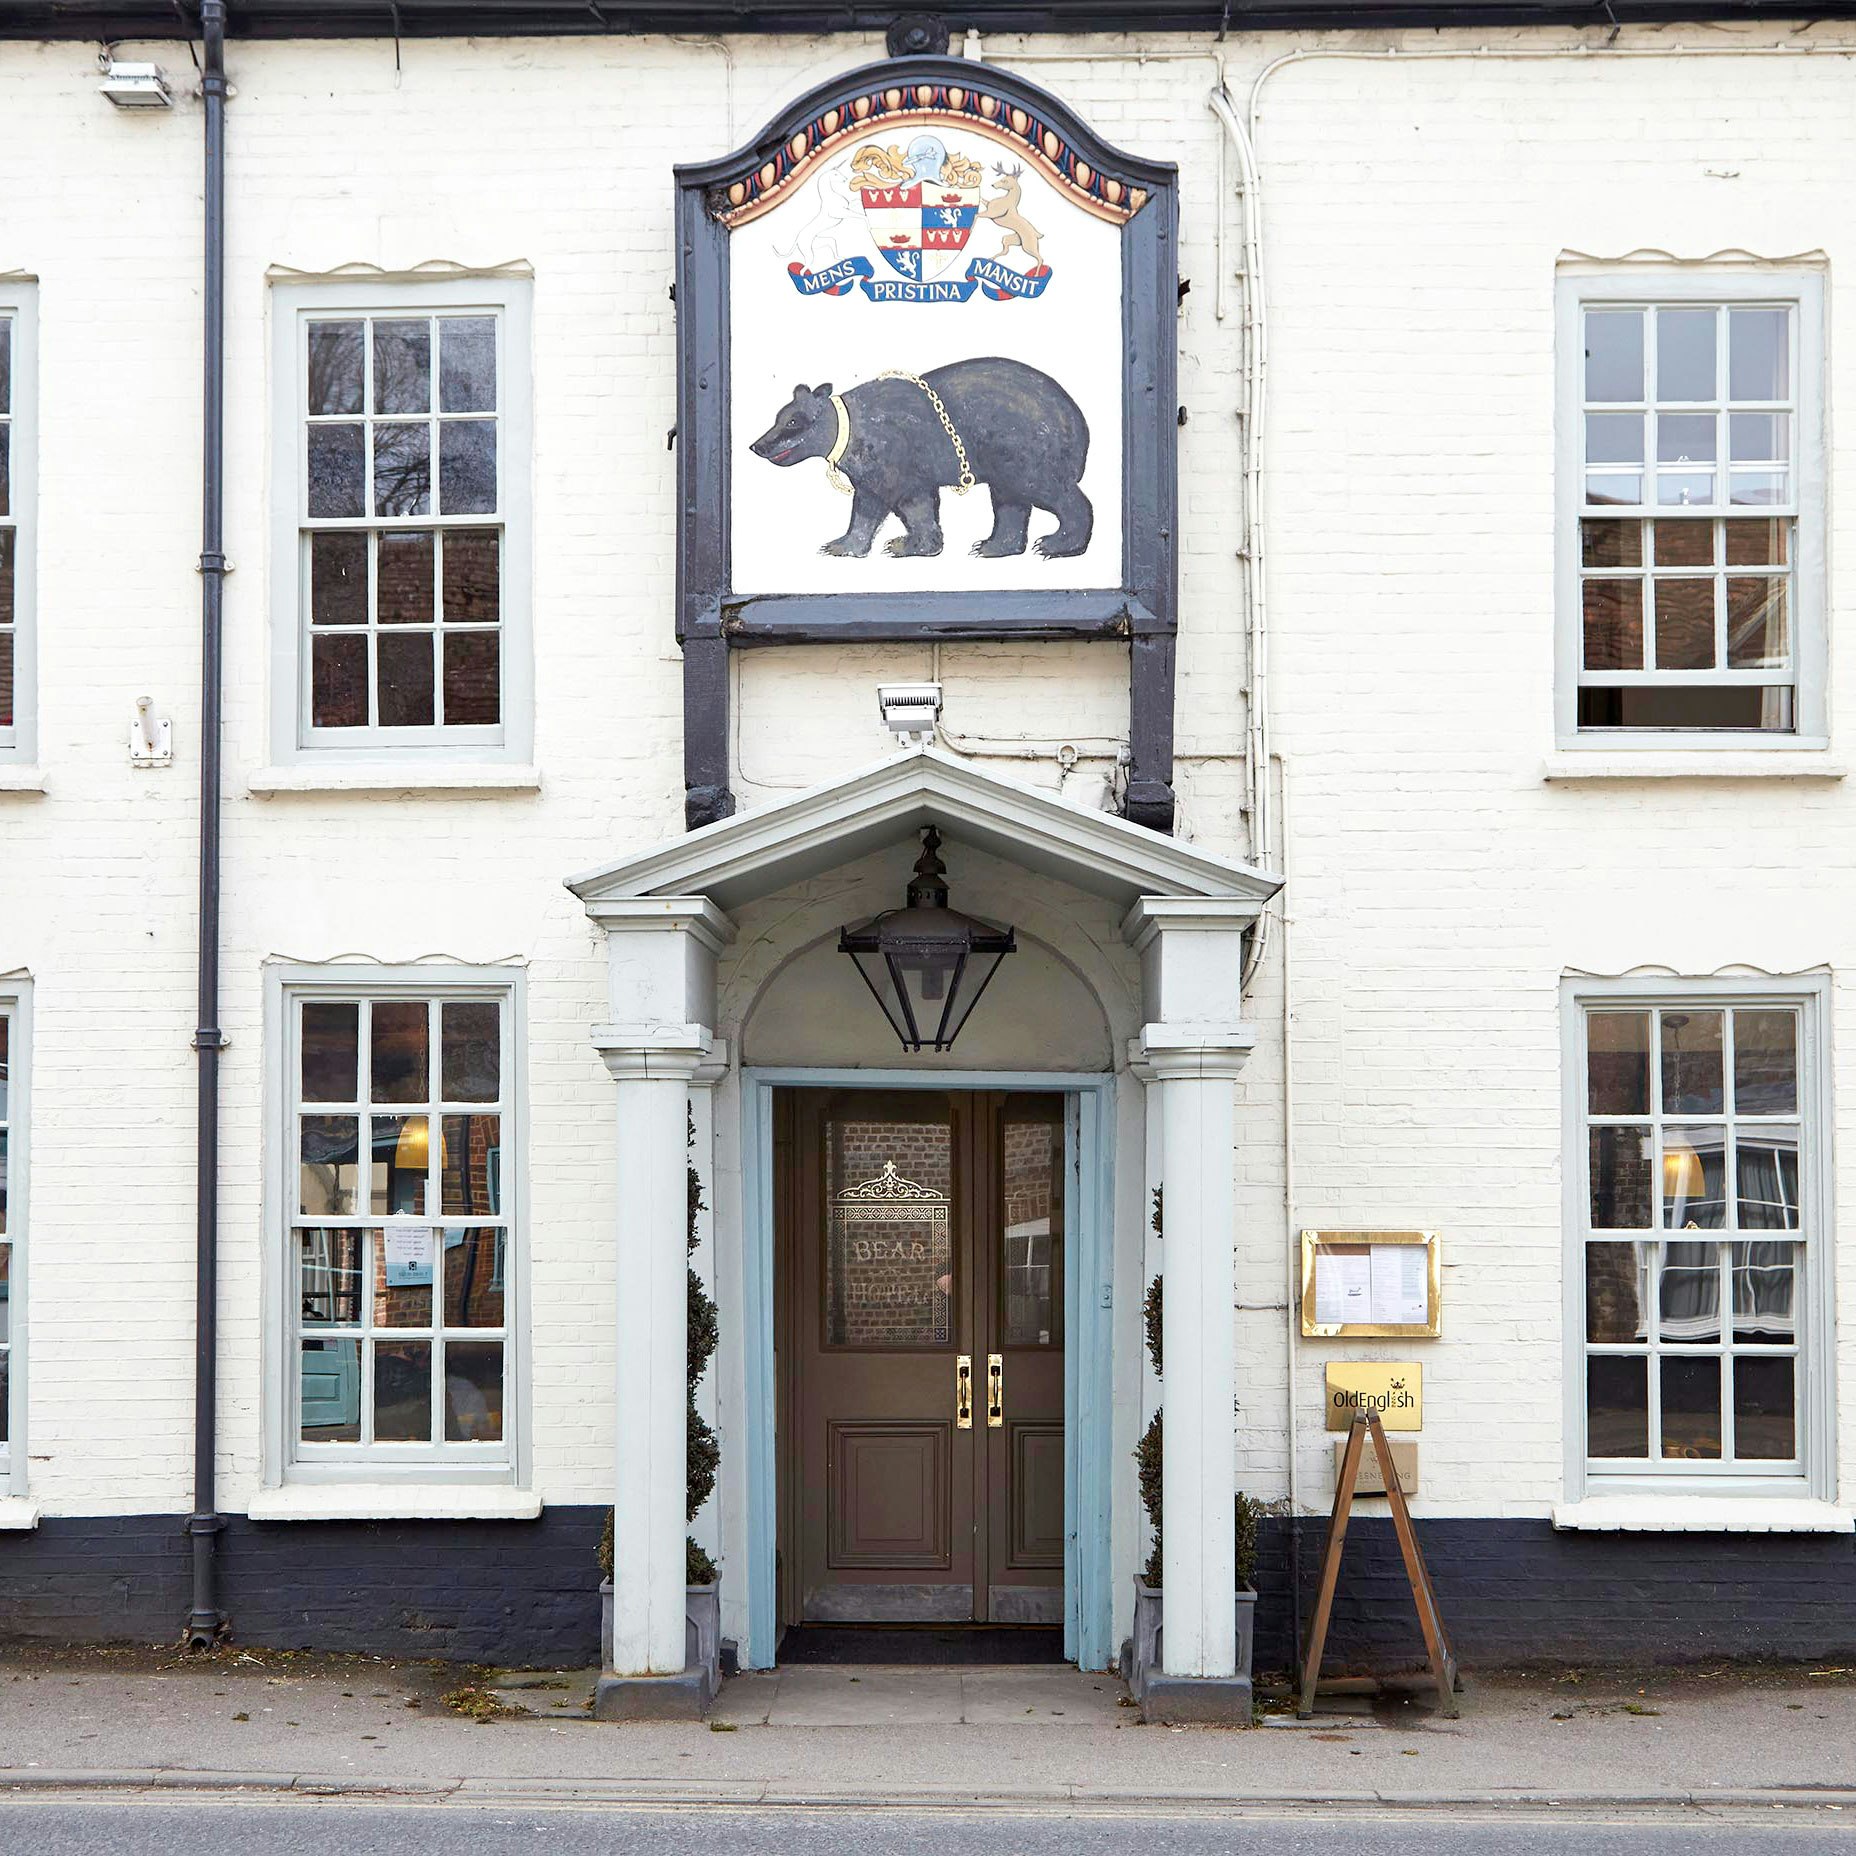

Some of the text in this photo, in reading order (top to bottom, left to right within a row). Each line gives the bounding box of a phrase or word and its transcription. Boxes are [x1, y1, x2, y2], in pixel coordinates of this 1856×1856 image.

[803, 259, 1039, 300] MENS PRISTINA MANSIT
[853, 1240, 925, 1261] BEAR
